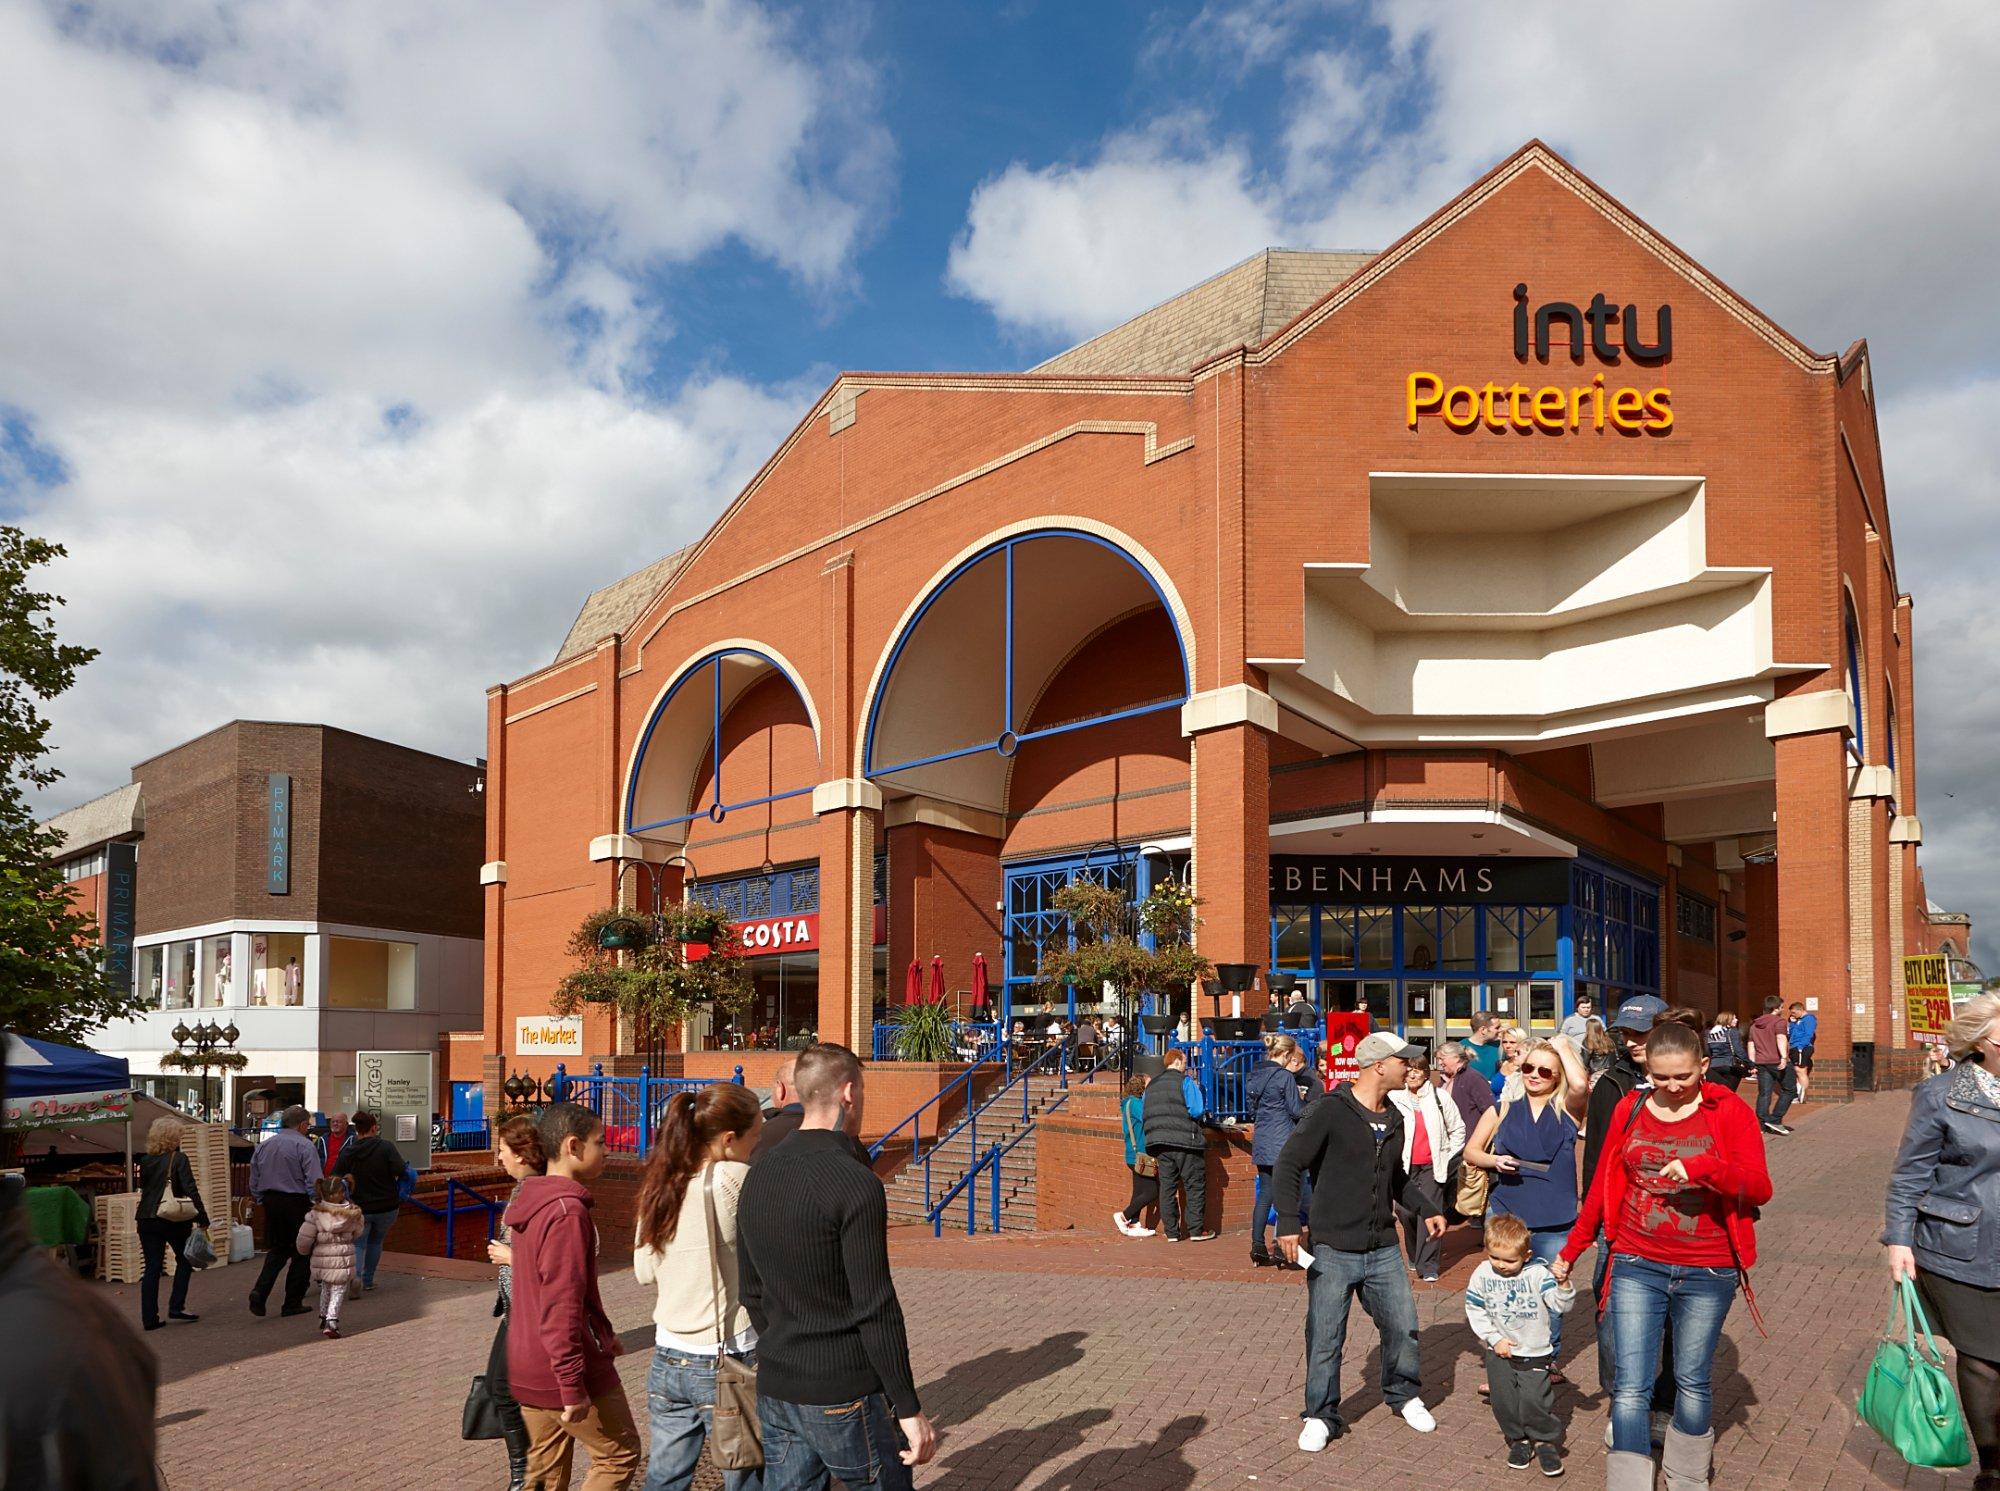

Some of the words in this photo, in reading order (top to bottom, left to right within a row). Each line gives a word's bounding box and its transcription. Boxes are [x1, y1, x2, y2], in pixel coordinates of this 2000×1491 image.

[1514, 283, 1672, 359] intu
[1406, 371, 1674, 431] Potteries
[273, 787, 284, 881] PRIMARK
[1269, 867, 1493, 893] BENHAMS
[113, 873, 130, 970] PRIMARK
[742, 920, 810, 948] COSTA
[1904, 960, 1923, 985] CITY
[1924, 959, 1947, 985] CAFE
[521, 1026, 539, 1045] The
[541, 1025, 577, 1045] Market
[1335, 1058, 1345, 1066] now
[365, 1059, 382, 1129] arket
[387, 1079, 410, 1087] Hanley
[29, 1098, 100, 1118] Here
